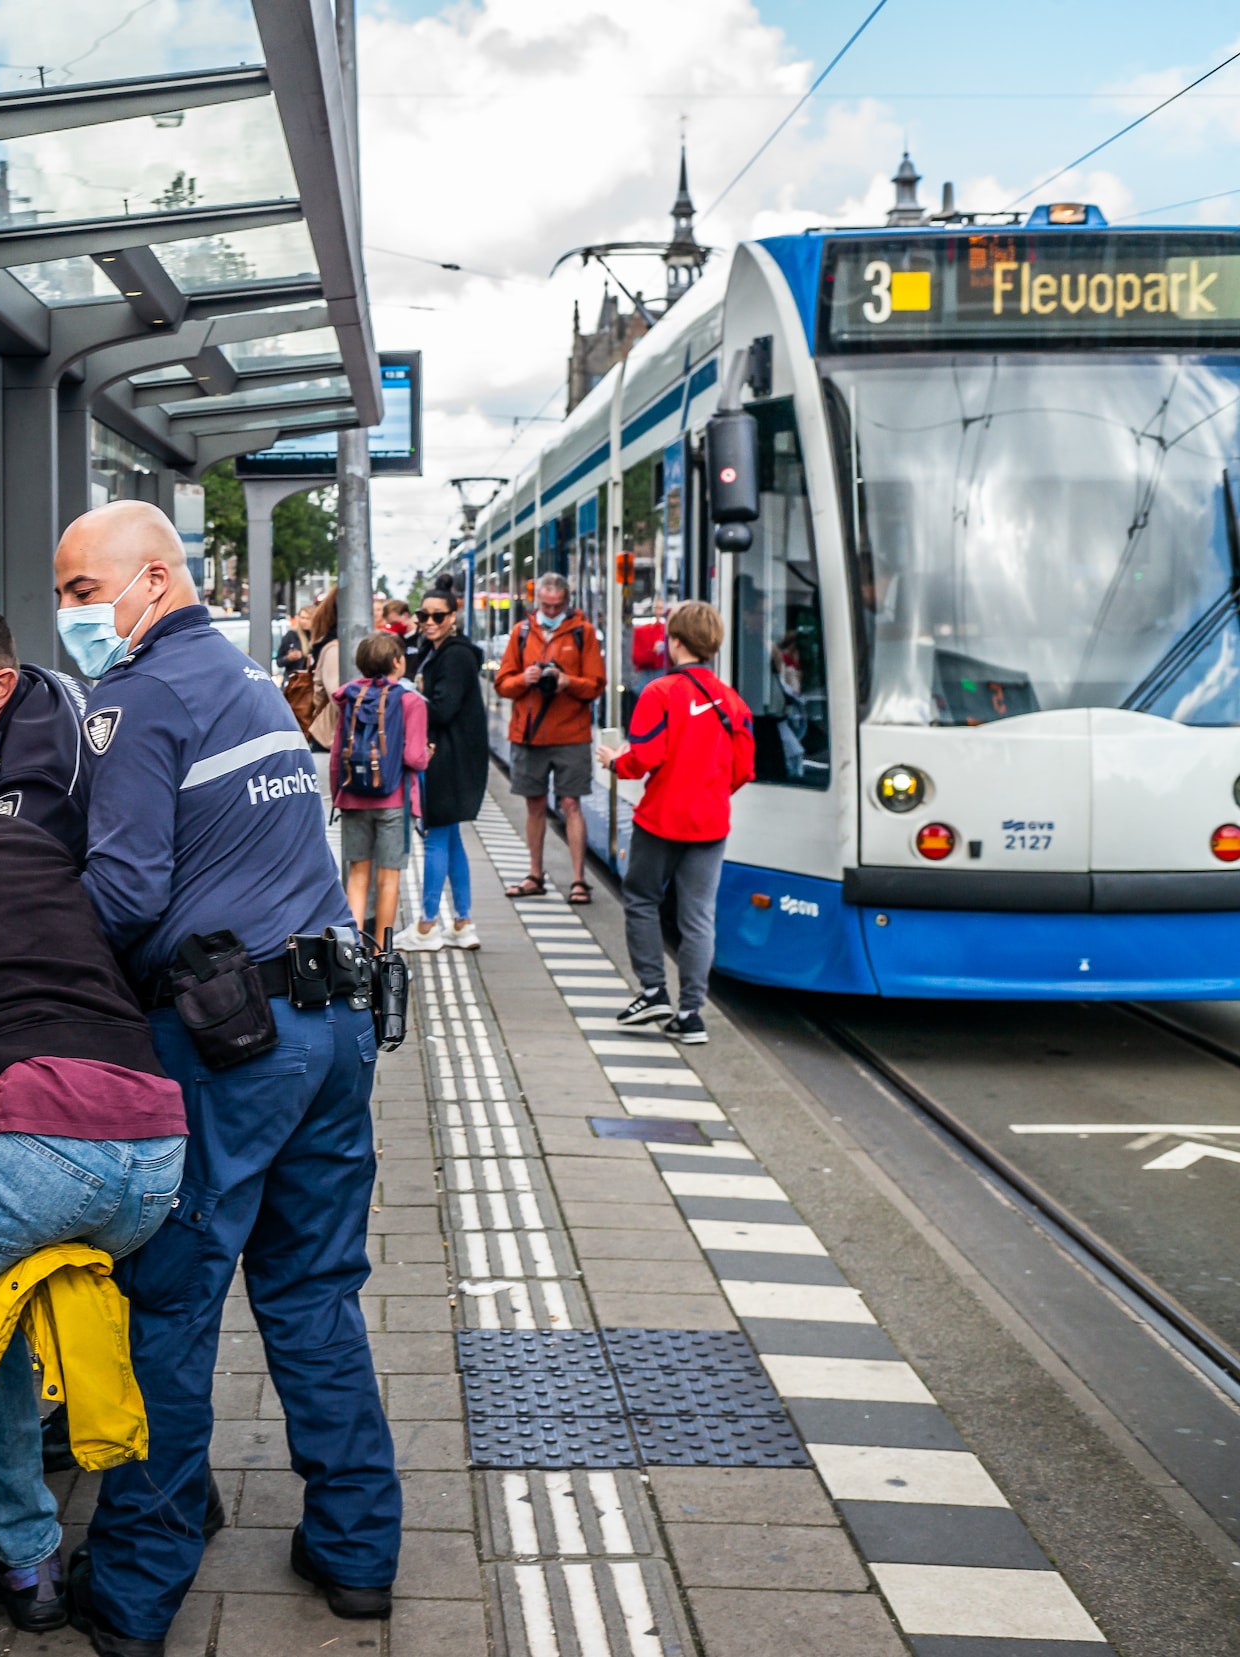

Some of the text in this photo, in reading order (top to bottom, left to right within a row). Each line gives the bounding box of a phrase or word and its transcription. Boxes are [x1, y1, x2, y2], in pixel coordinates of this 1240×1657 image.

[862, 260, 892, 324] 3
[992, 259, 1219, 318] Flevopark
[1005, 835, 1053, 850] 2127
